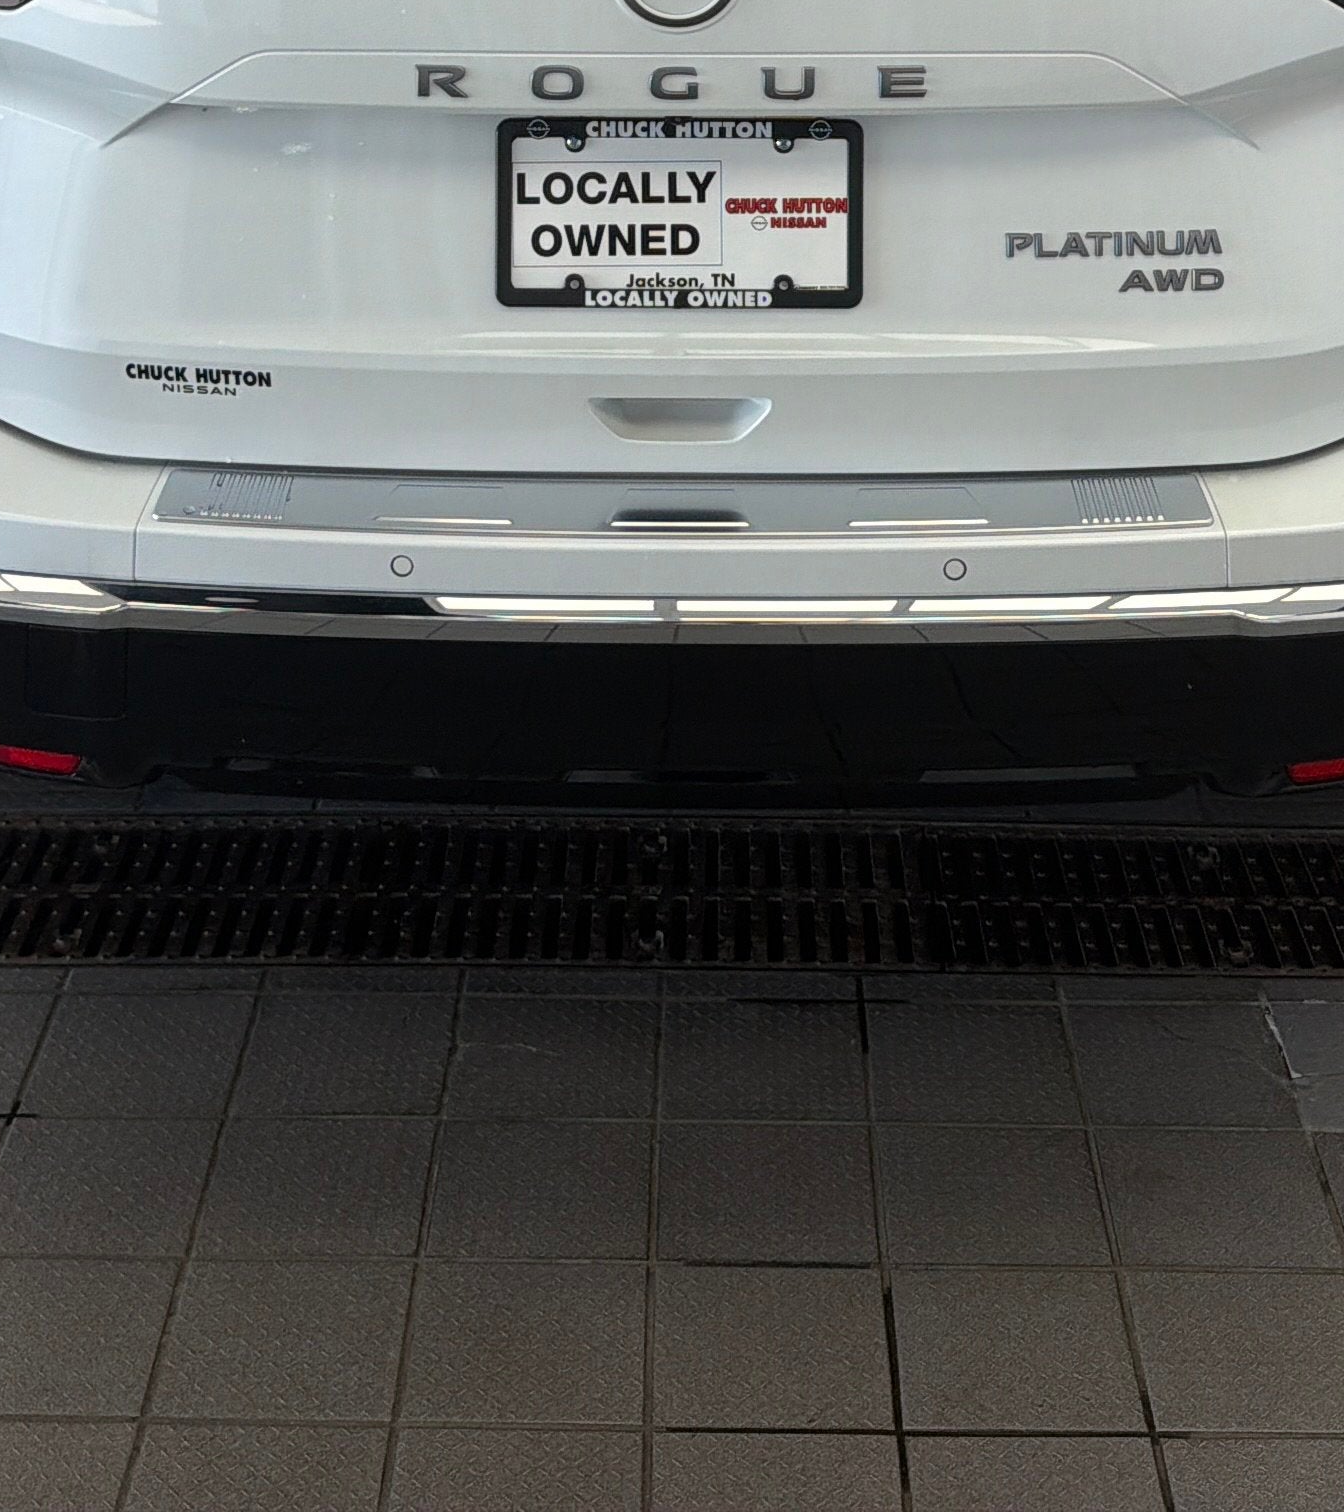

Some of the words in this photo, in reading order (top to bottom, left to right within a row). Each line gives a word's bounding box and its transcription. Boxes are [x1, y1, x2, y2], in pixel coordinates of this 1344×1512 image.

[415, 64, 929, 101] ROGUE
[585, 120, 667, 138] CHUCK
[675, 121, 773, 138] HUTTON
[516, 171, 717, 204] LOCALLY
[725, 198, 778, 214] CHUCK
[782, 197, 848, 214] HUTTON
[770, 217, 827, 228] NISSAN
[531, 223, 700, 257] OWNED
[1005, 229, 1223, 258] PLATINUM
[626, 273, 704, 289] Jackson,
[711, 273, 735, 287] TN
[1118, 268, 1225, 293] AWD
[585, 290, 679, 307] LOCALLY
[687, 290, 773, 307] OWNED
[125, 363, 188, 383] CHUCK
[195, 367, 272, 388] HUTTON
[162, 383, 237, 397] NISSAN
